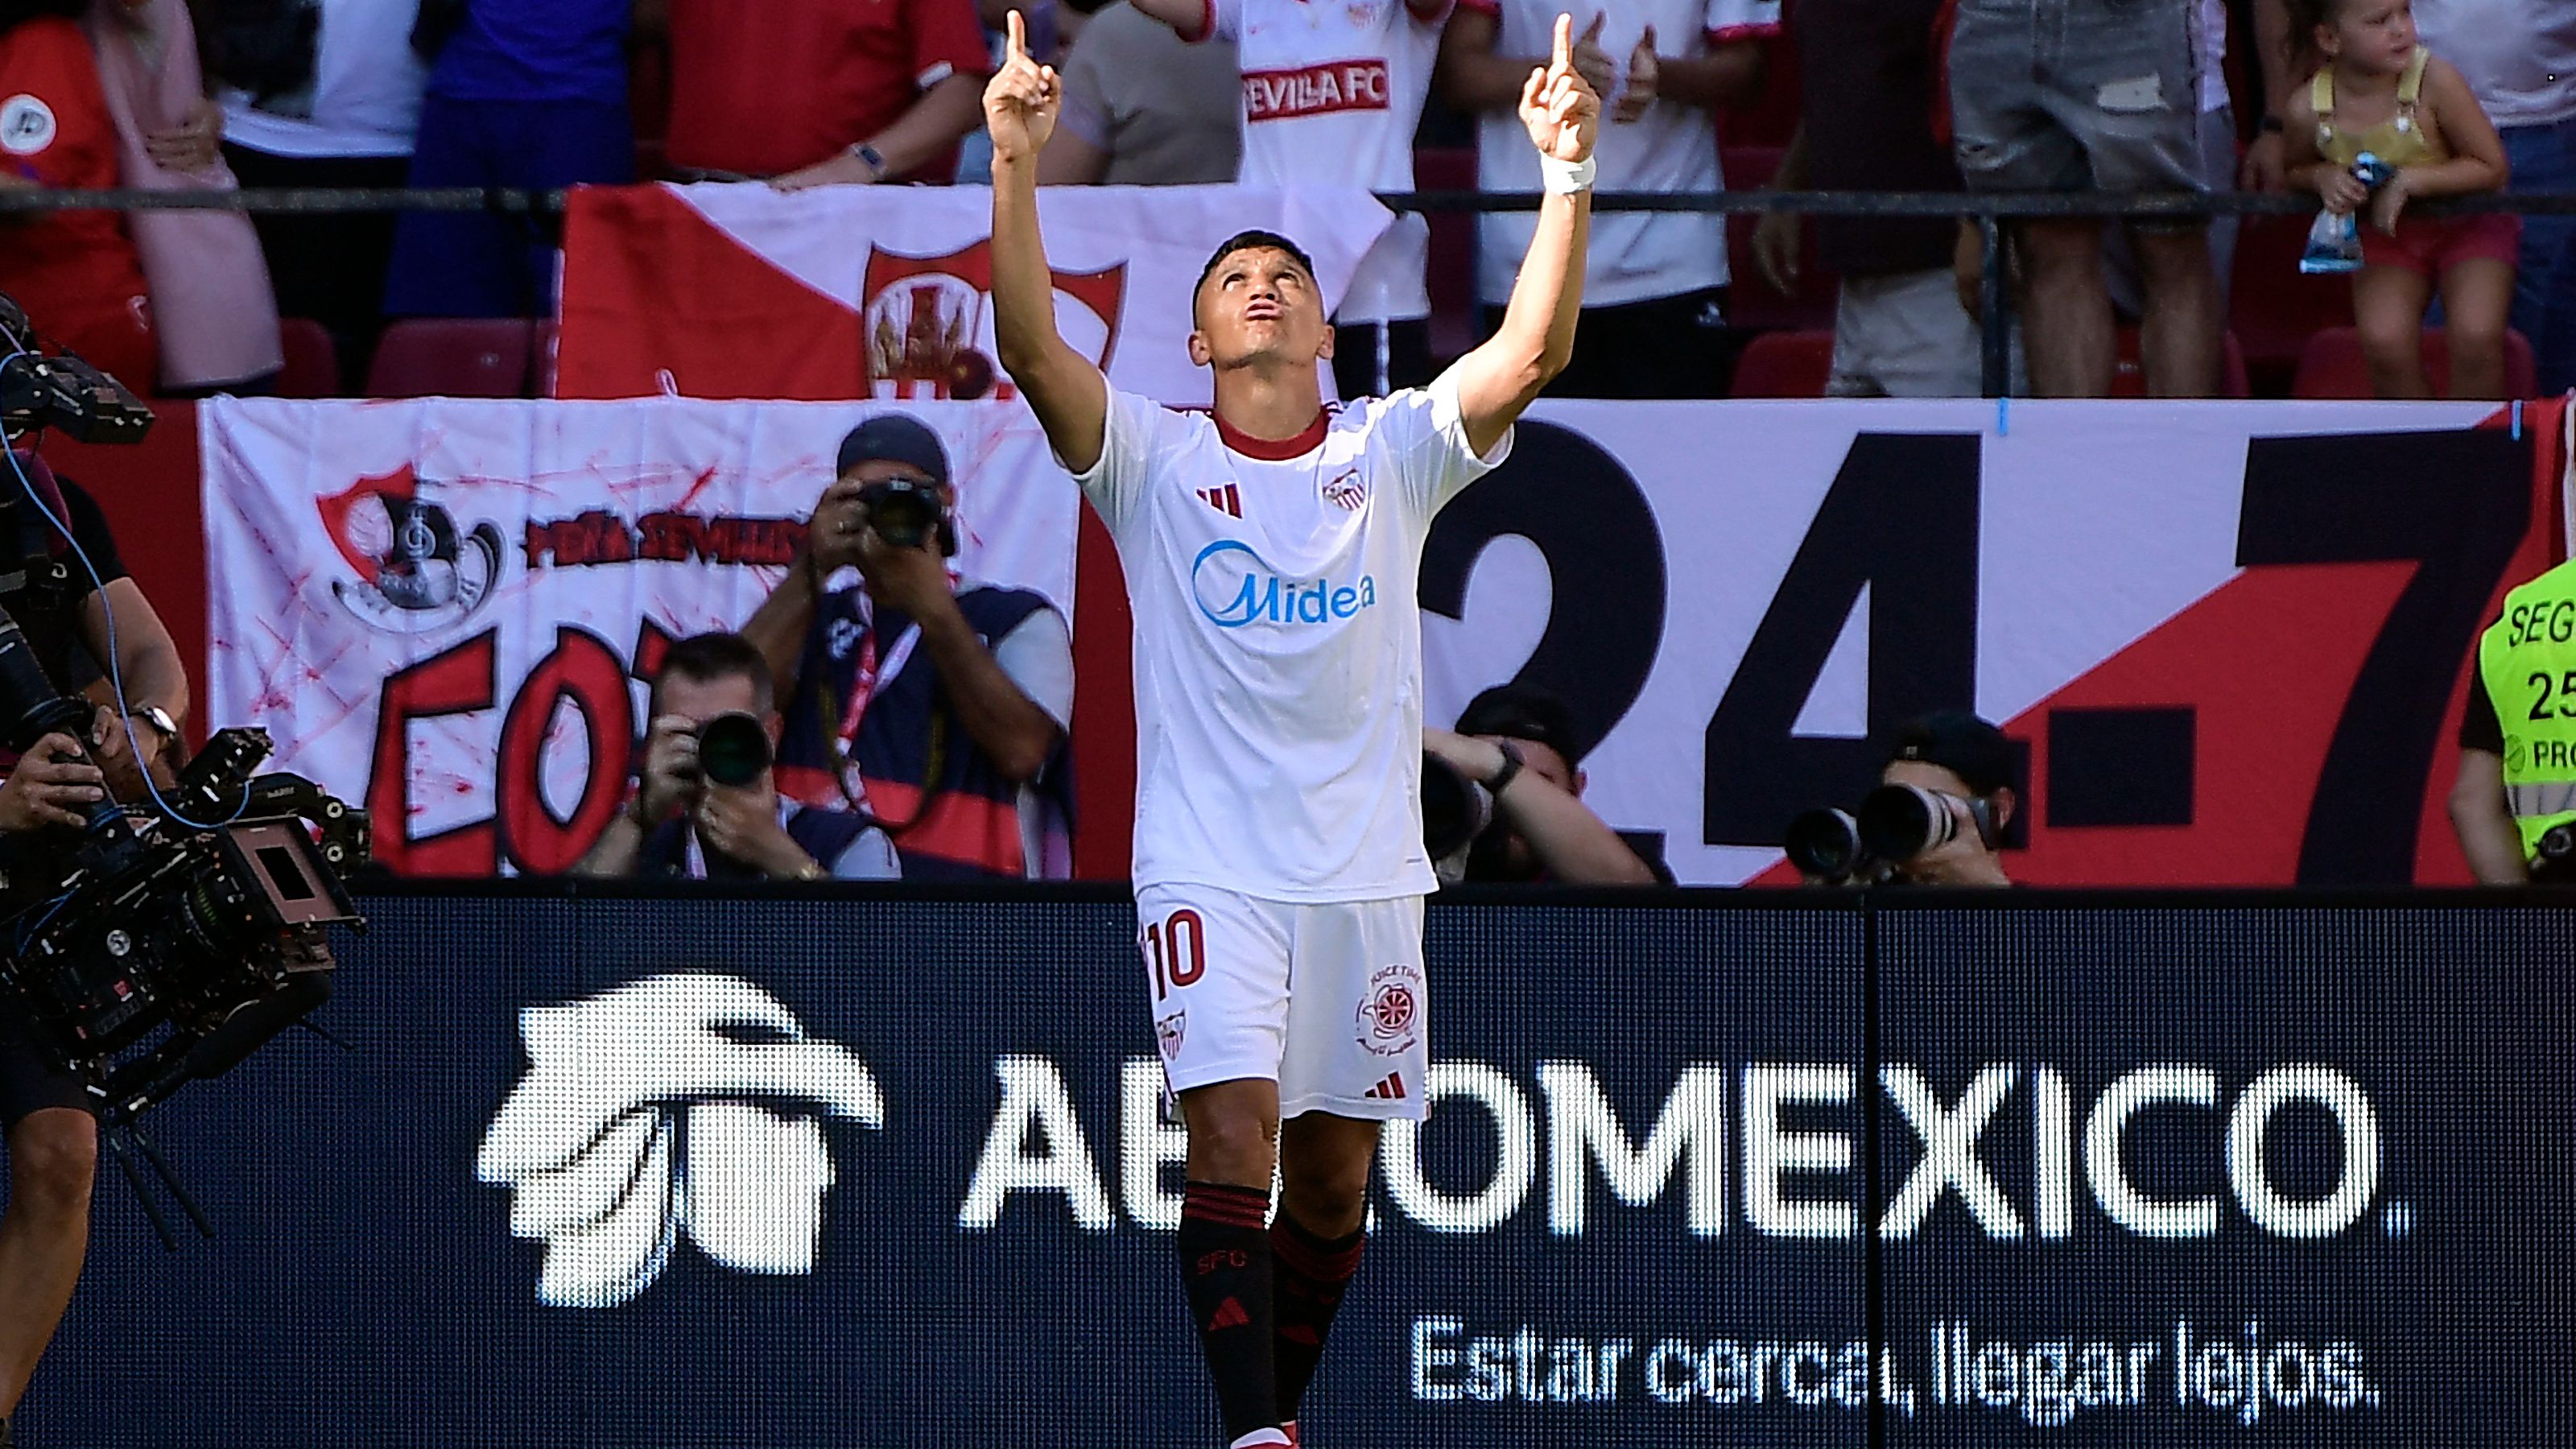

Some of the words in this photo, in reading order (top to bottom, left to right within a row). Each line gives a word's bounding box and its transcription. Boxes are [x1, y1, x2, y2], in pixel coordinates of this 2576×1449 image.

[1346, 60, 1386, 103] FC
[1192, 540, 1376, 627] Midea
[2528, 671, 2576, 720] 25
[1147, 909, 1205, 1002] 10
[1412, 1315, 1633, 1402] Estar
[1646, 1336, 1913, 1419] cerca,
[1931, 1317, 2160, 1428] llegar
[2176, 1317, 2380, 1427] lejos.
